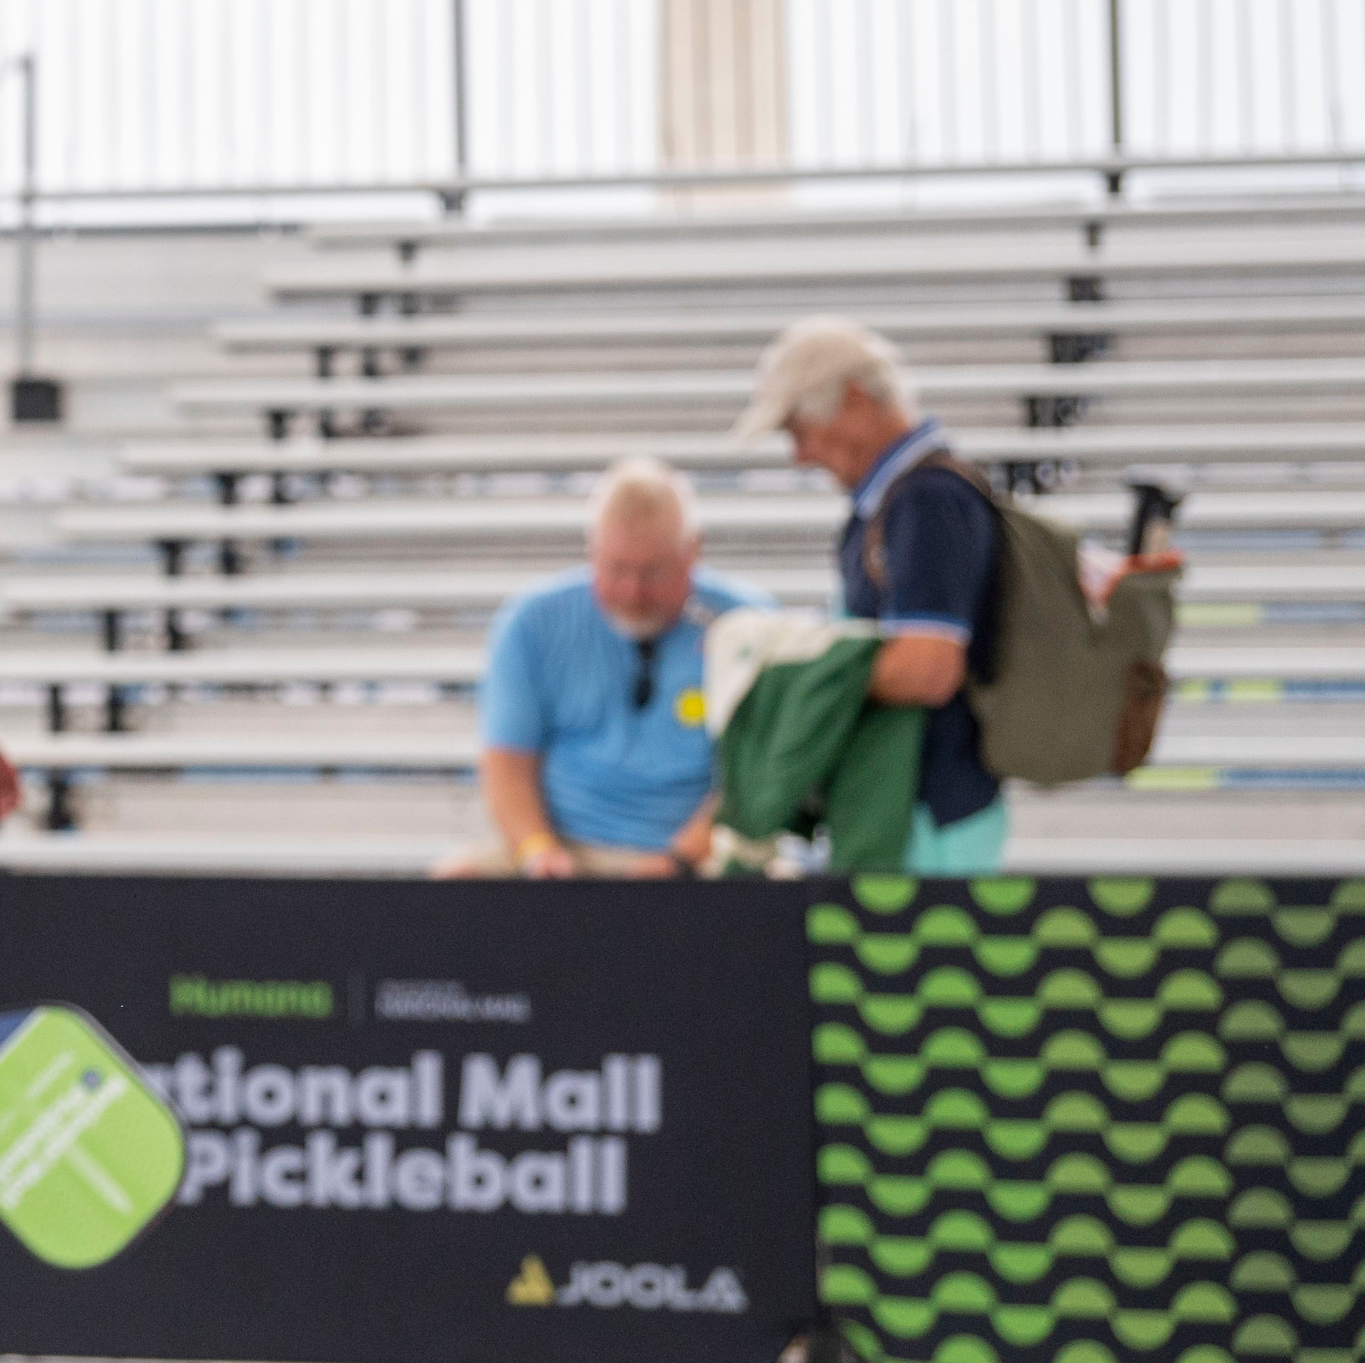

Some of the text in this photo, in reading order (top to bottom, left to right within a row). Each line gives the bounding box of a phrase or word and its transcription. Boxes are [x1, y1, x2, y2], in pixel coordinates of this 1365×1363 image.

[457, 1052, 663, 1134] Mall
[177, 1128, 628, 1215] Pickleball
[555, 1259, 749, 1314] JOOLA
